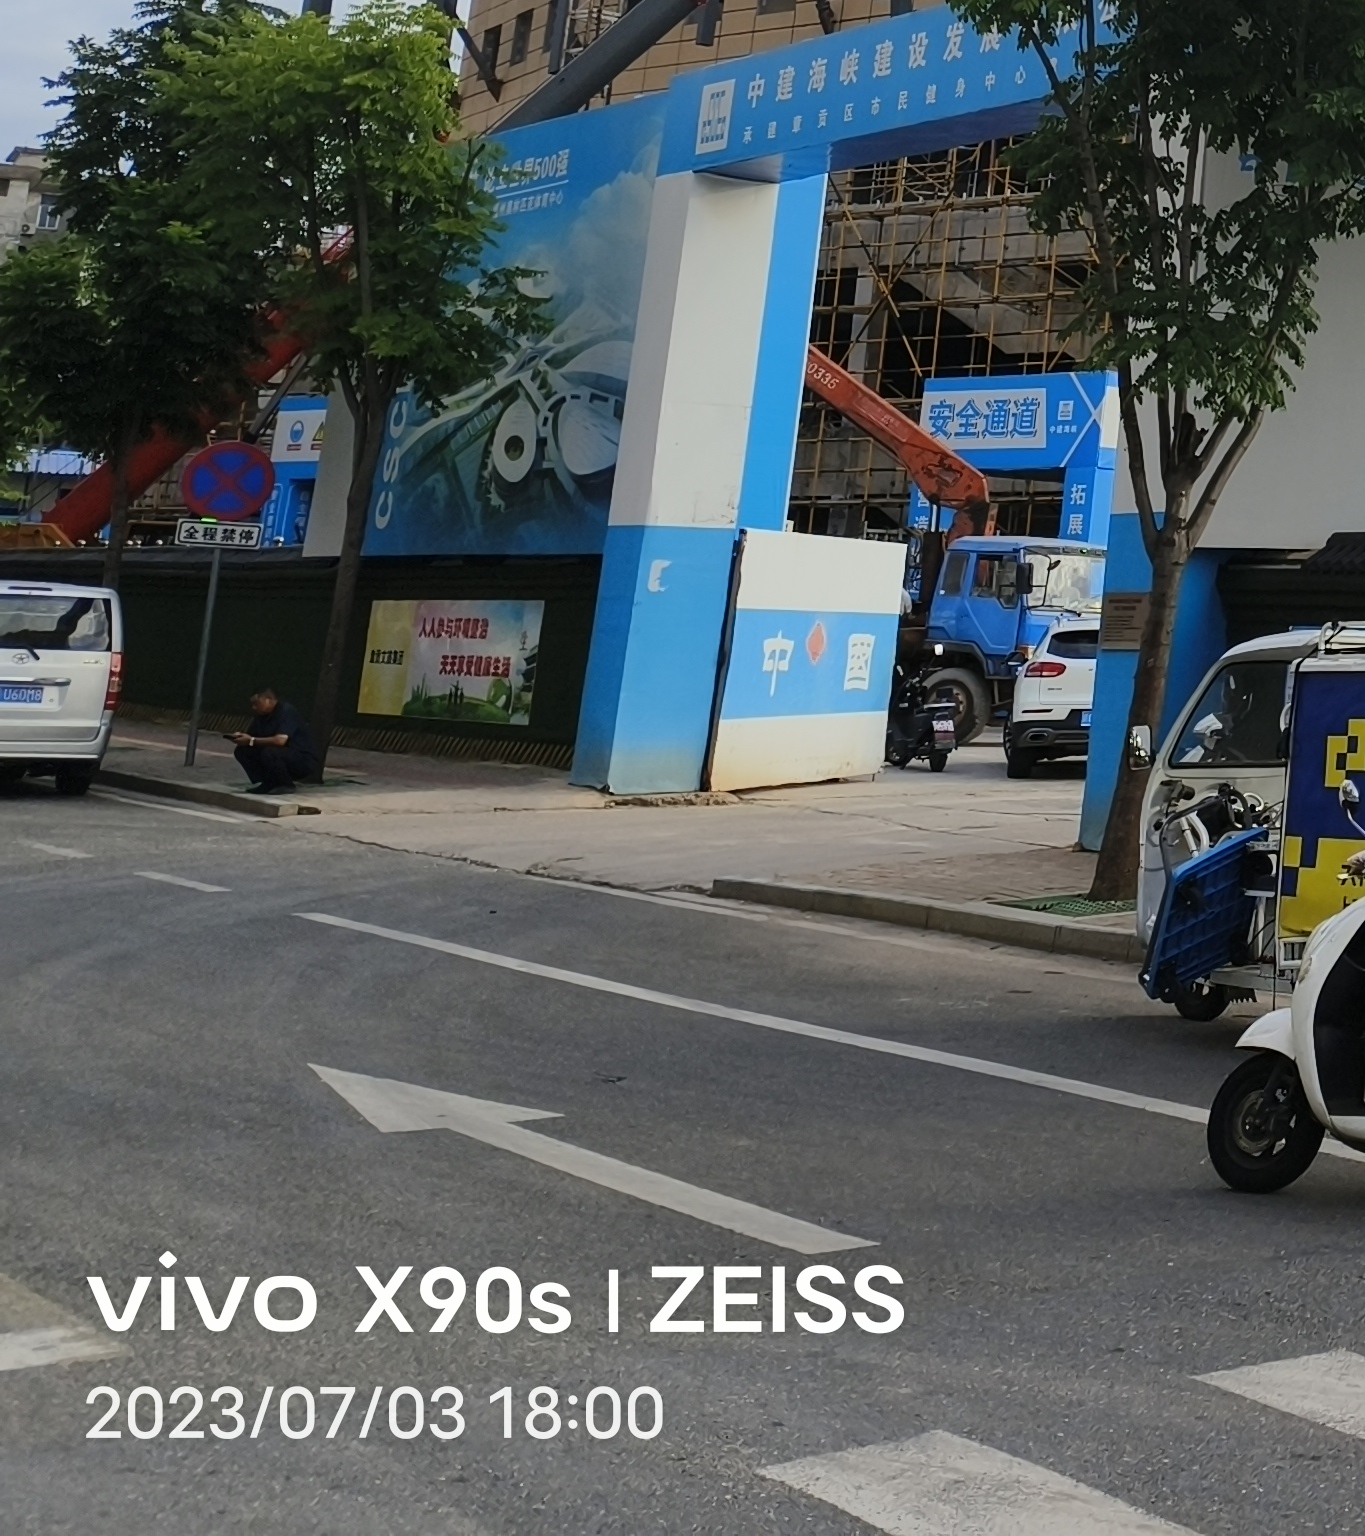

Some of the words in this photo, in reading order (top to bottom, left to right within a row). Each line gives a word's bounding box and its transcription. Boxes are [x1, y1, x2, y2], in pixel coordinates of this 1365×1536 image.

[929, 398, 1041, 440] 安全通道
[1067, 483, 1087, 536] 拓展
[183, 525, 254, 544] 全程禁停
[438, 654, 512, 679] 天天享受健康生活
